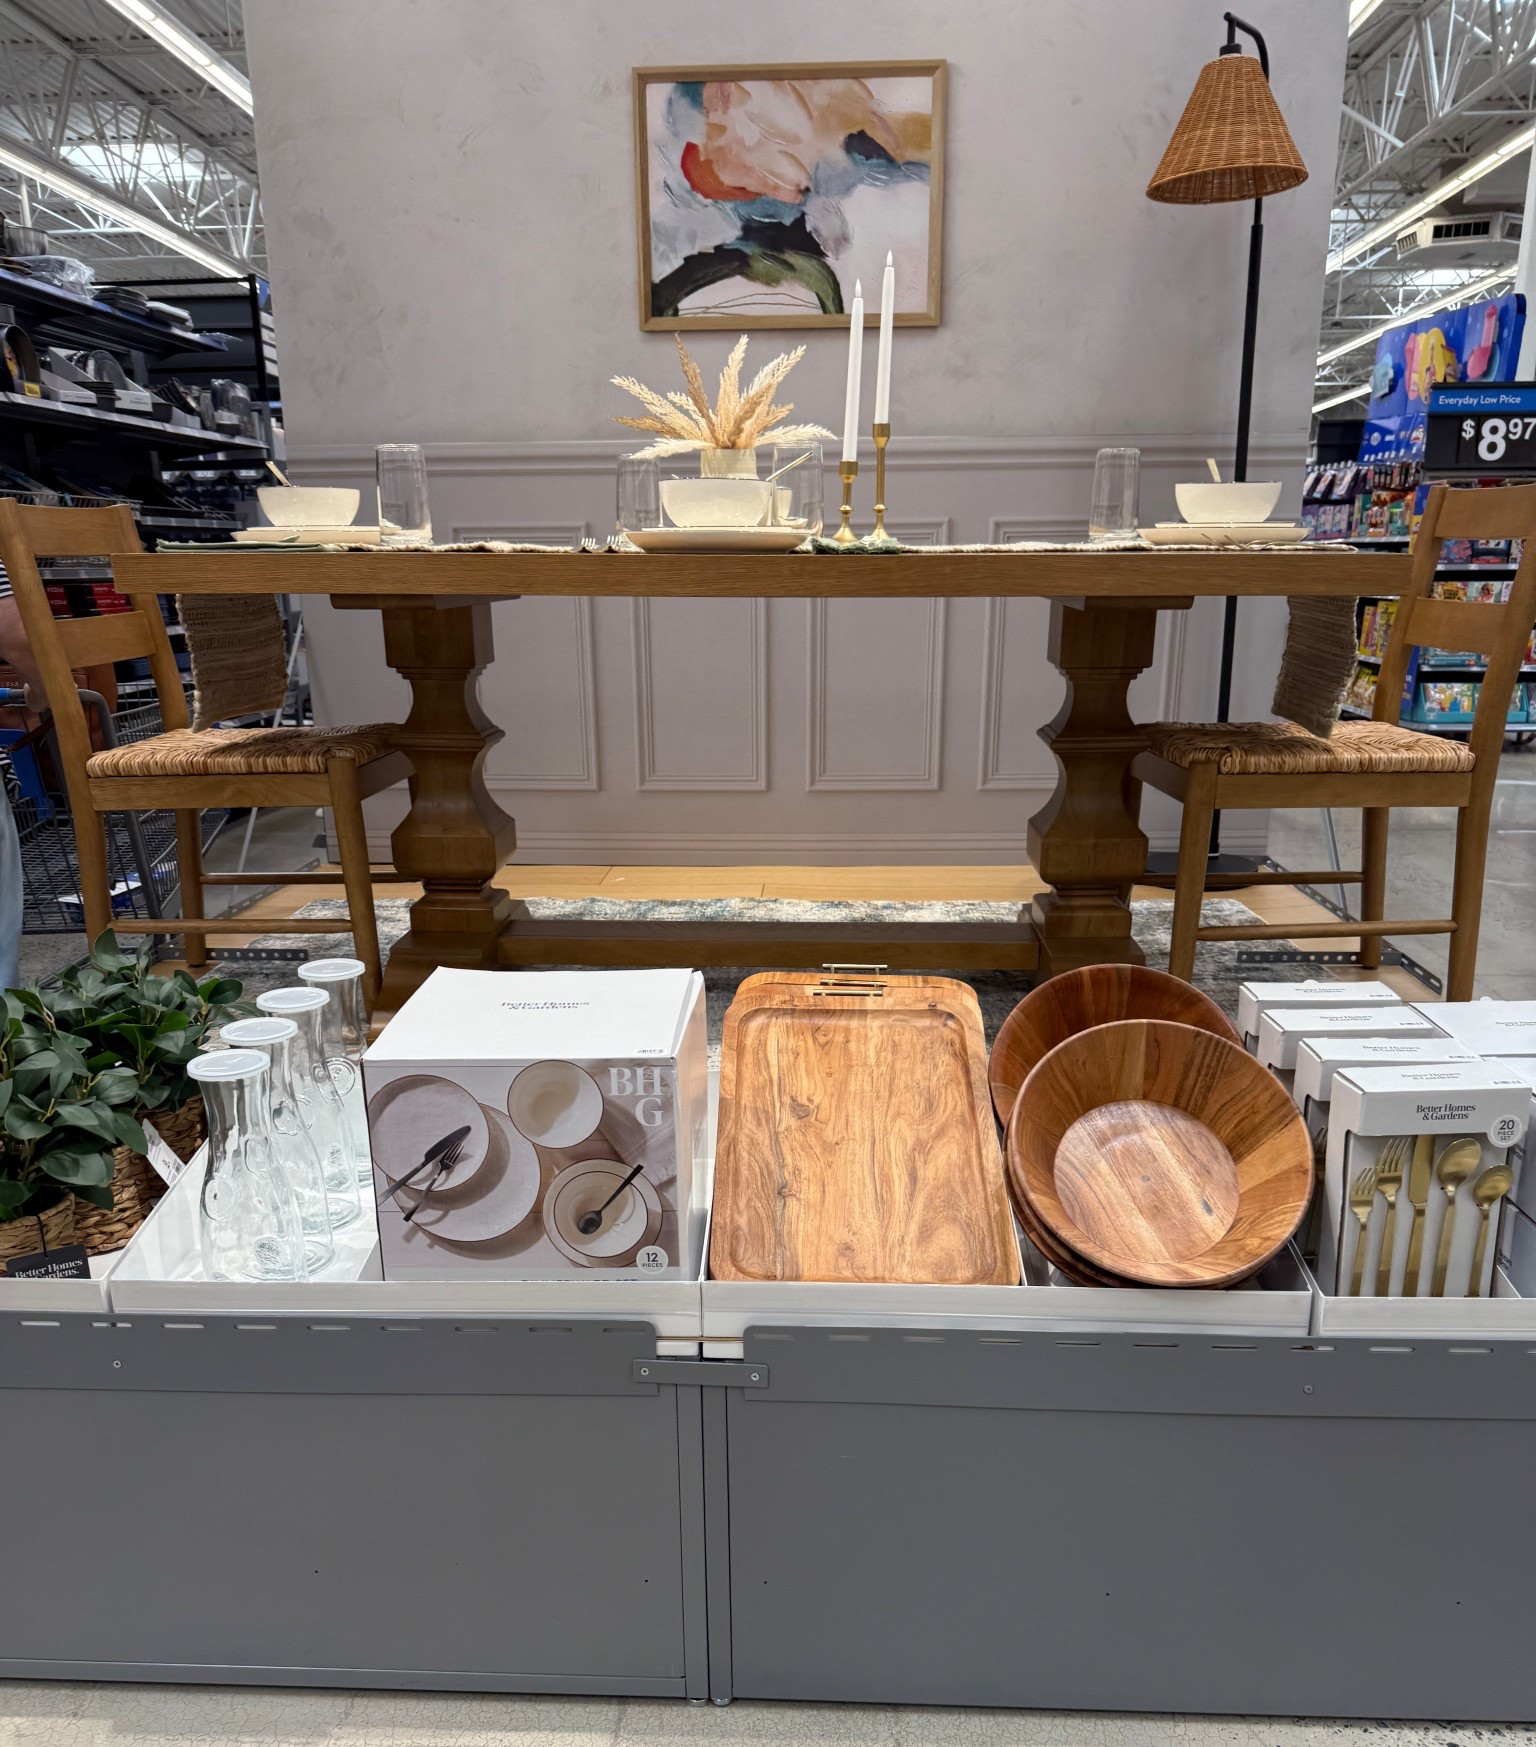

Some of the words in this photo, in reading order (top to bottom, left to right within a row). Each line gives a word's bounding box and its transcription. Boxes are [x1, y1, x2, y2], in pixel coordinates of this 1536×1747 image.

[1438, 395, 1478, 407] Everyday
[1480, 395, 1498, 404] Low
[1499, 394, 1521, 404] Price
[608, 1067, 664, 1096] BH
[635, 1097, 664, 1127] G
[1416, 1104, 1443, 1113] Better
[1444, 1103, 1476, 1112] Homes
[1422, 1112, 1430, 1120] &
[1430, 1111, 1469, 1120] Gardens
[1498, 1120, 1515, 1130] 20
[645, 1252, 659, 1263] 12
[15, 1267, 47, 1278] Better
[47, 1259, 83, 1273] Homes
